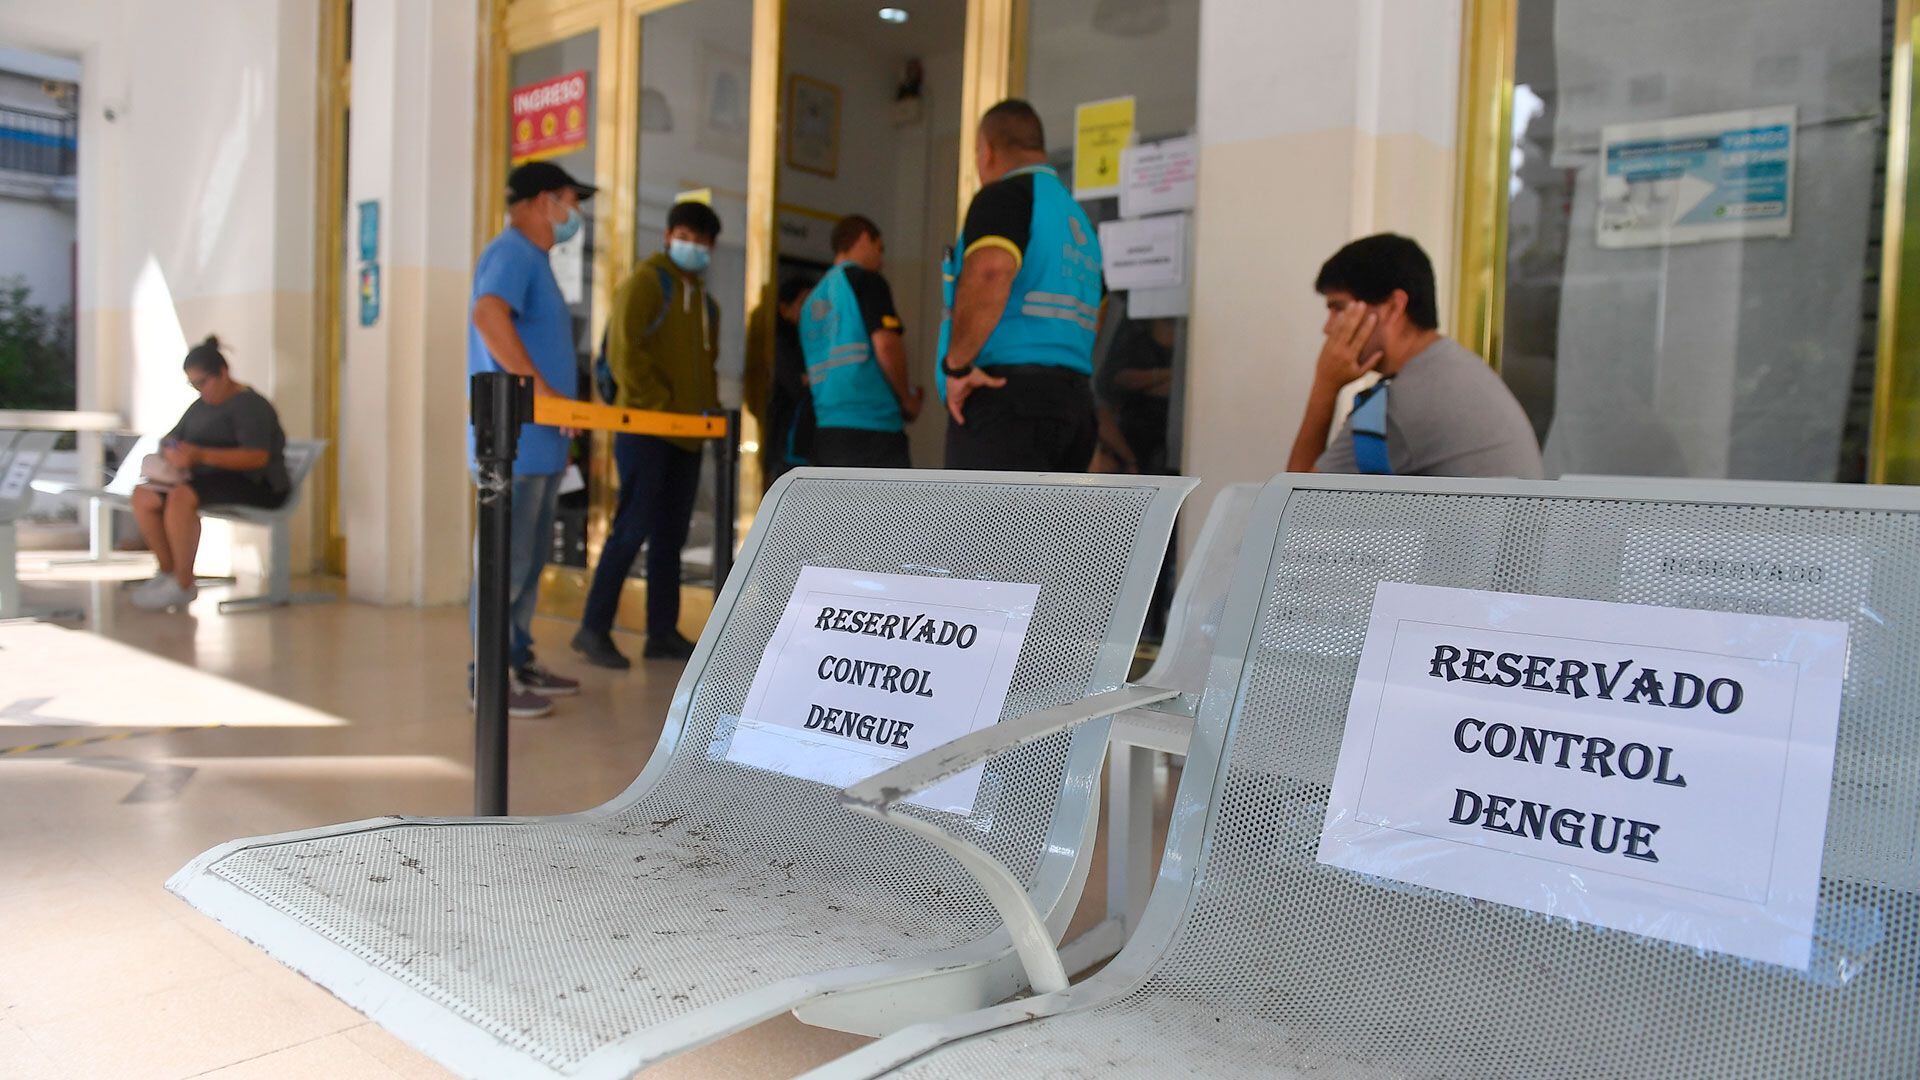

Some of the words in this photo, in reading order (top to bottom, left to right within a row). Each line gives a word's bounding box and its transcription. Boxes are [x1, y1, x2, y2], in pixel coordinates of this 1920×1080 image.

[513, 77, 584, 115] INGRESO
[815, 607, 978, 649] RESERVADO
[817, 655, 934, 697] CONTROL
[1429, 644, 1744, 715] RESERVADO
[803, 704, 915, 749] DENGUE
[1454, 717, 1688, 788] CONTROL
[1449, 788, 1661, 863] DENGUE
